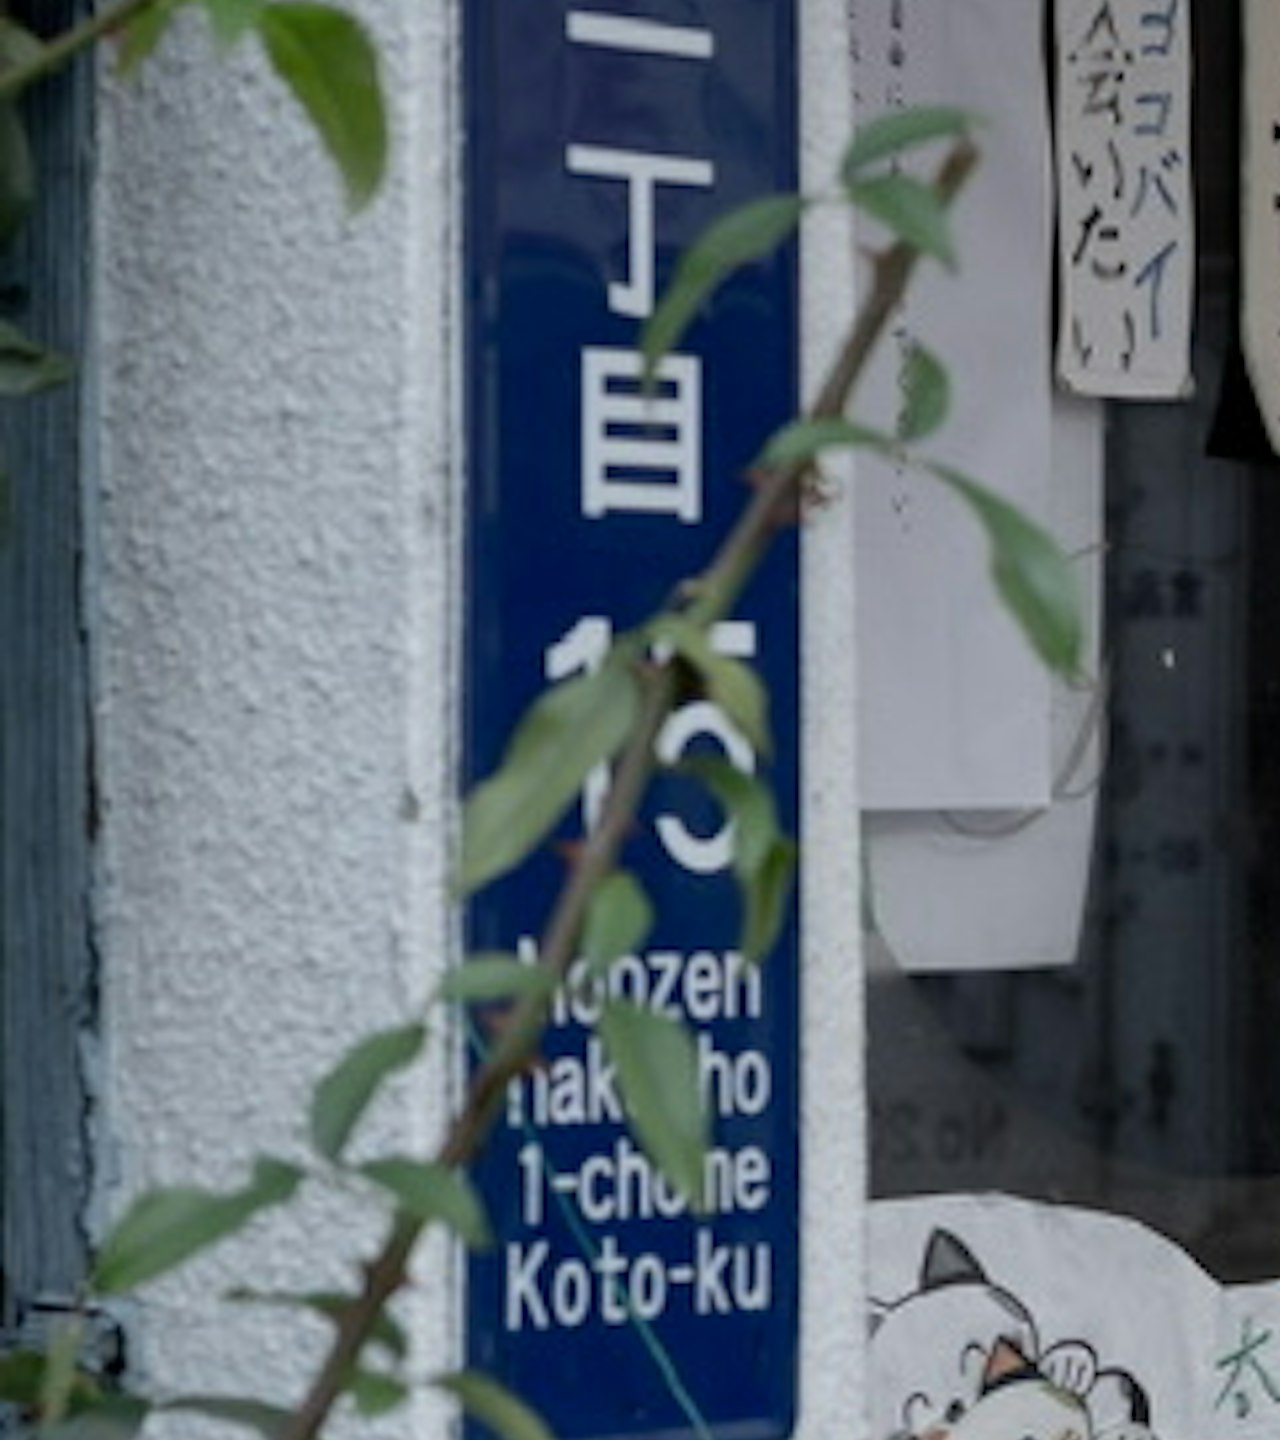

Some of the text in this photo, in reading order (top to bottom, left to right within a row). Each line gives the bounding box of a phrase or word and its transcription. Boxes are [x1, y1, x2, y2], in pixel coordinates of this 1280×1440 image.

[519, 939, 761, 1020] onzen
[508, 1035, 770, 1127] nakho
[505, 1230, 771, 1329] Koto-ku
